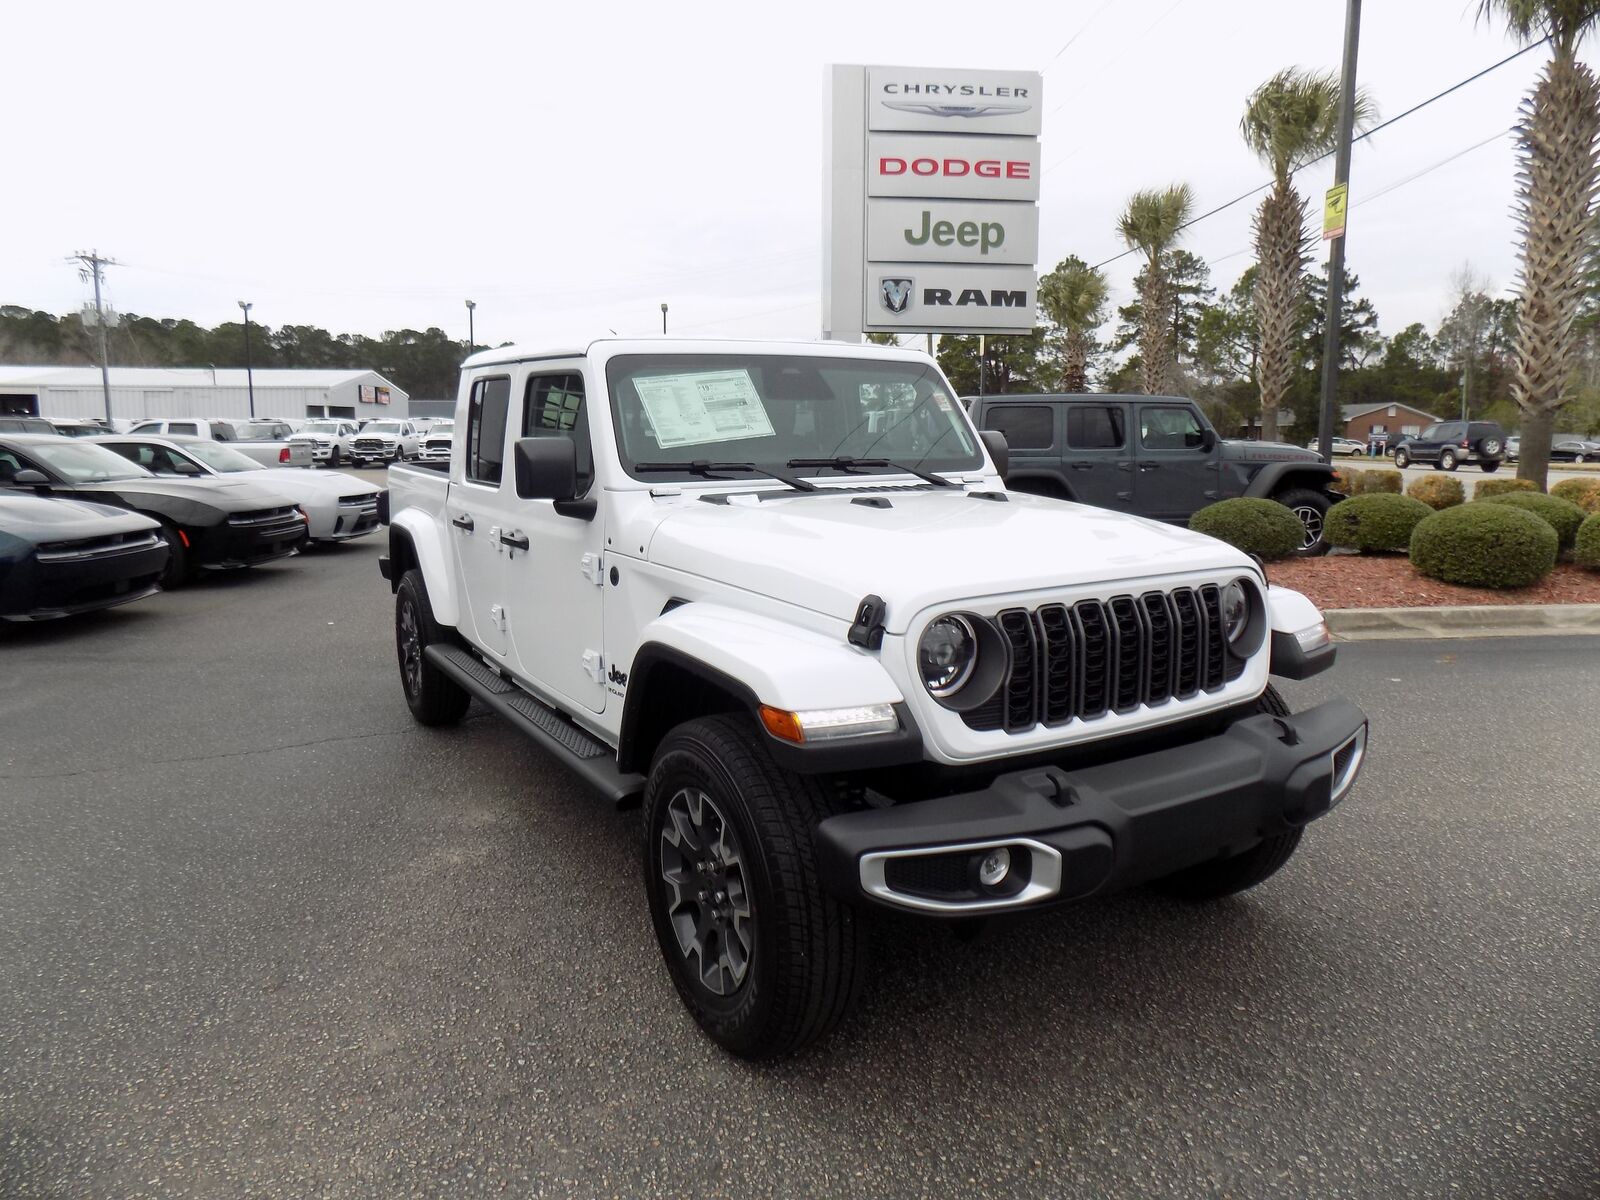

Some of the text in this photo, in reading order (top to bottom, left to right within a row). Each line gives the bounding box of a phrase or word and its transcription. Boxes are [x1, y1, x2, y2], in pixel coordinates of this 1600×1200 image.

[883, 83, 1029, 98] CHRYSLER
[879, 157, 1031, 180] DODGE
[904, 211, 1005, 255] Jeep
[923, 288, 1027, 308] RAM
[608, 664, 628, 687] Jee
